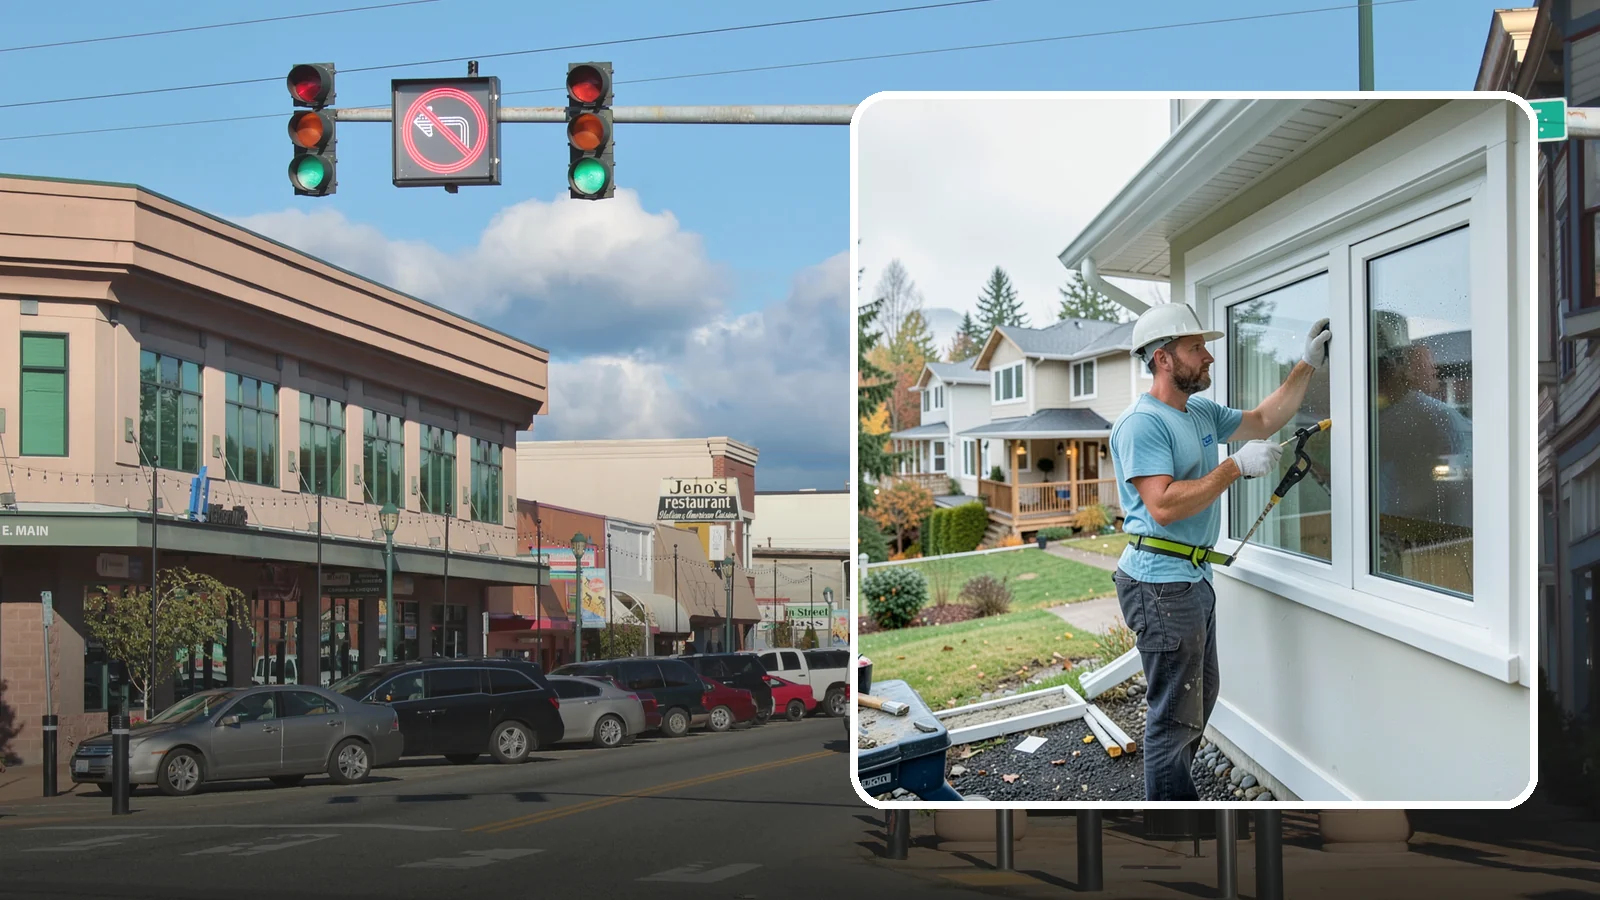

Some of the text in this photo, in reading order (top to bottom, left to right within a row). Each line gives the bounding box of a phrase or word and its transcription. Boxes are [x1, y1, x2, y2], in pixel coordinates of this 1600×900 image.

[670, 480, 728, 494] Jeno's
[665, 496, 731, 509] restaurant
[659, 510, 682, 519] Italian
[686, 510, 715, 519] American
[715, 510, 738, 519] Cuisine
[2, 525, 49, 536] E. MAIN
[797, 608, 829, 617] Street
